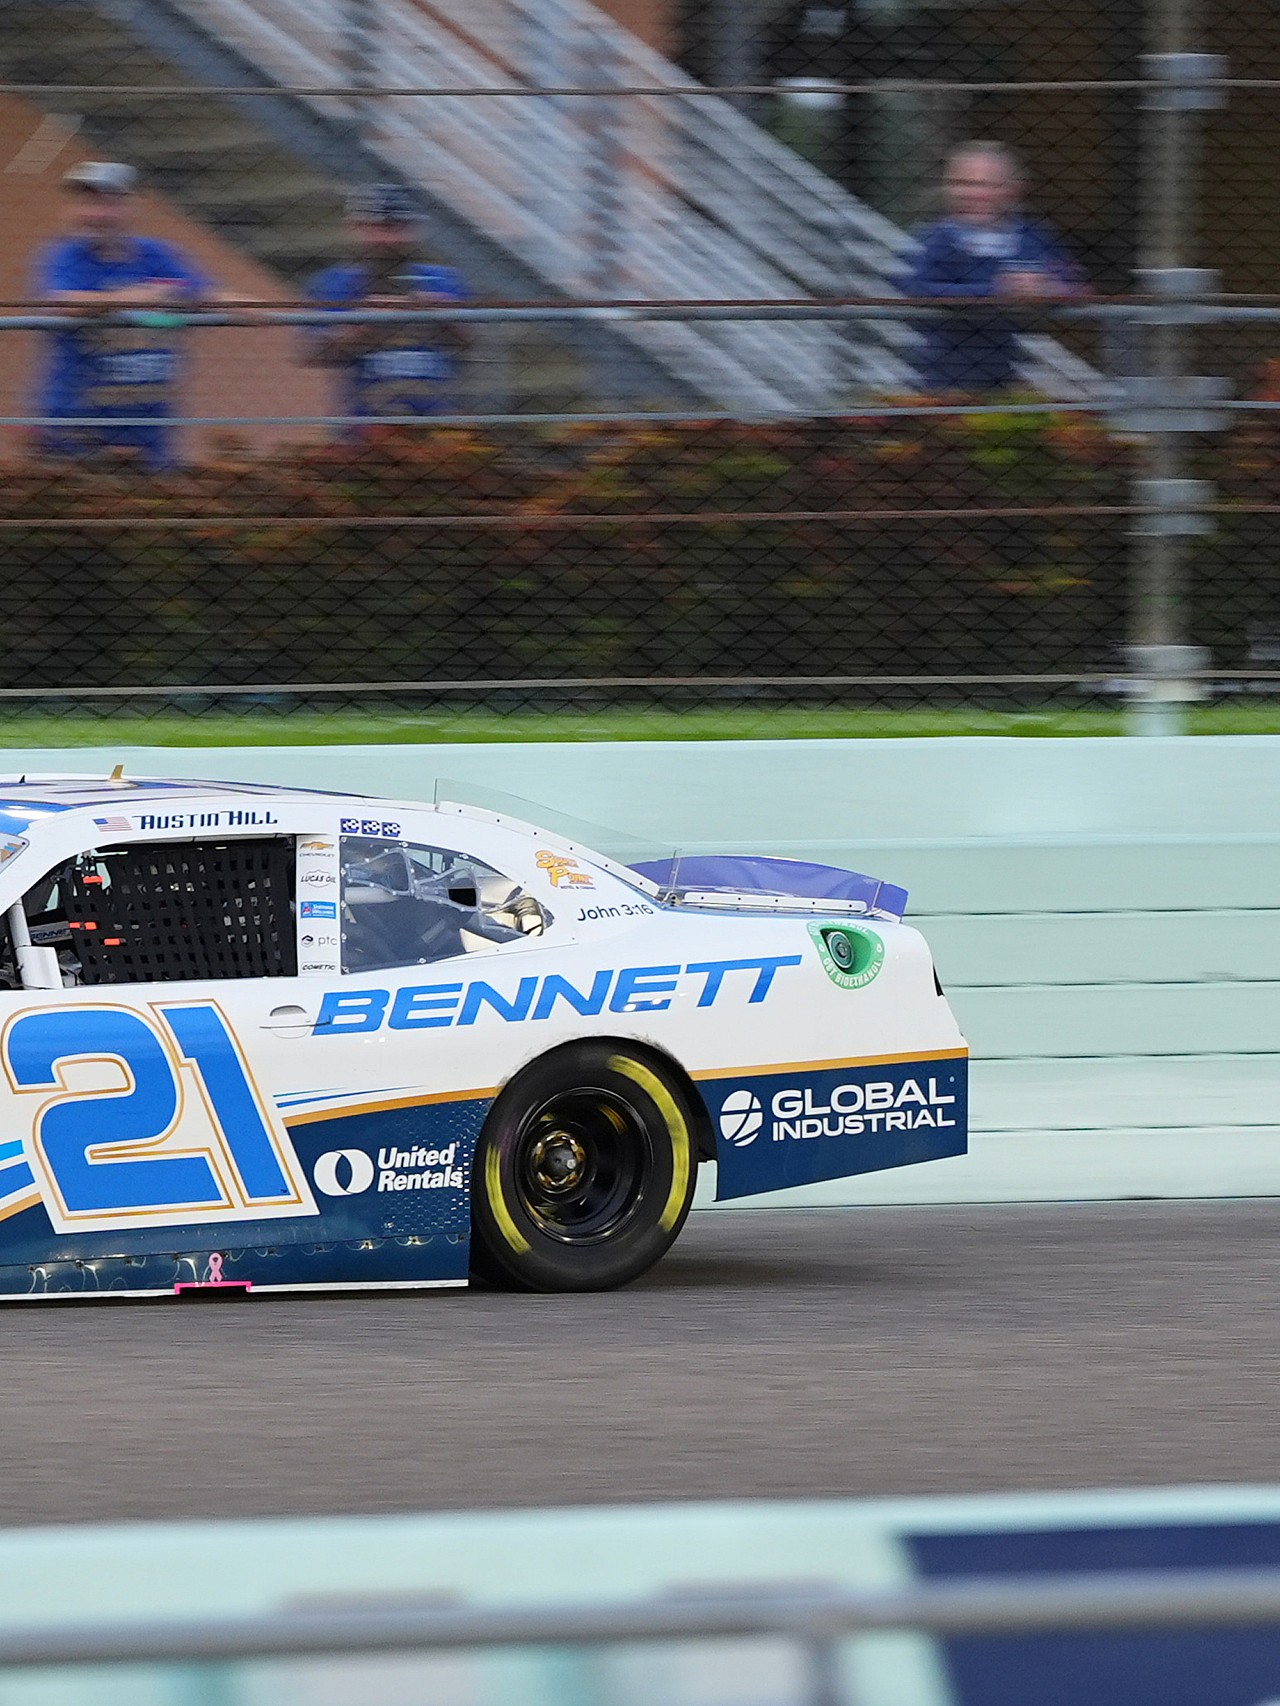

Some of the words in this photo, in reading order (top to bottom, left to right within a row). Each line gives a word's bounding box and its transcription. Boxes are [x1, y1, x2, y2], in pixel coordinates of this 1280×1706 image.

[132, 813, 220, 830] AUSTIN
[220, 810, 278, 827] HILL
[300, 874, 323, 883] LUCAS
[325, 875, 336, 883] OIL
[577, 906, 621, 921] John
[621, 904, 654, 915] 3:16
[318, 936, 338, 947] ptc
[312, 955, 802, 1036] BENNETT
[0, 1000, 303, 1221] 21
[770, 1077, 956, 1119] GLOBAL
[771, 1107, 956, 1142] INDUSTRIAL
[377, 1142, 455, 1169] United
[377, 1167, 464, 1193] Rentals
